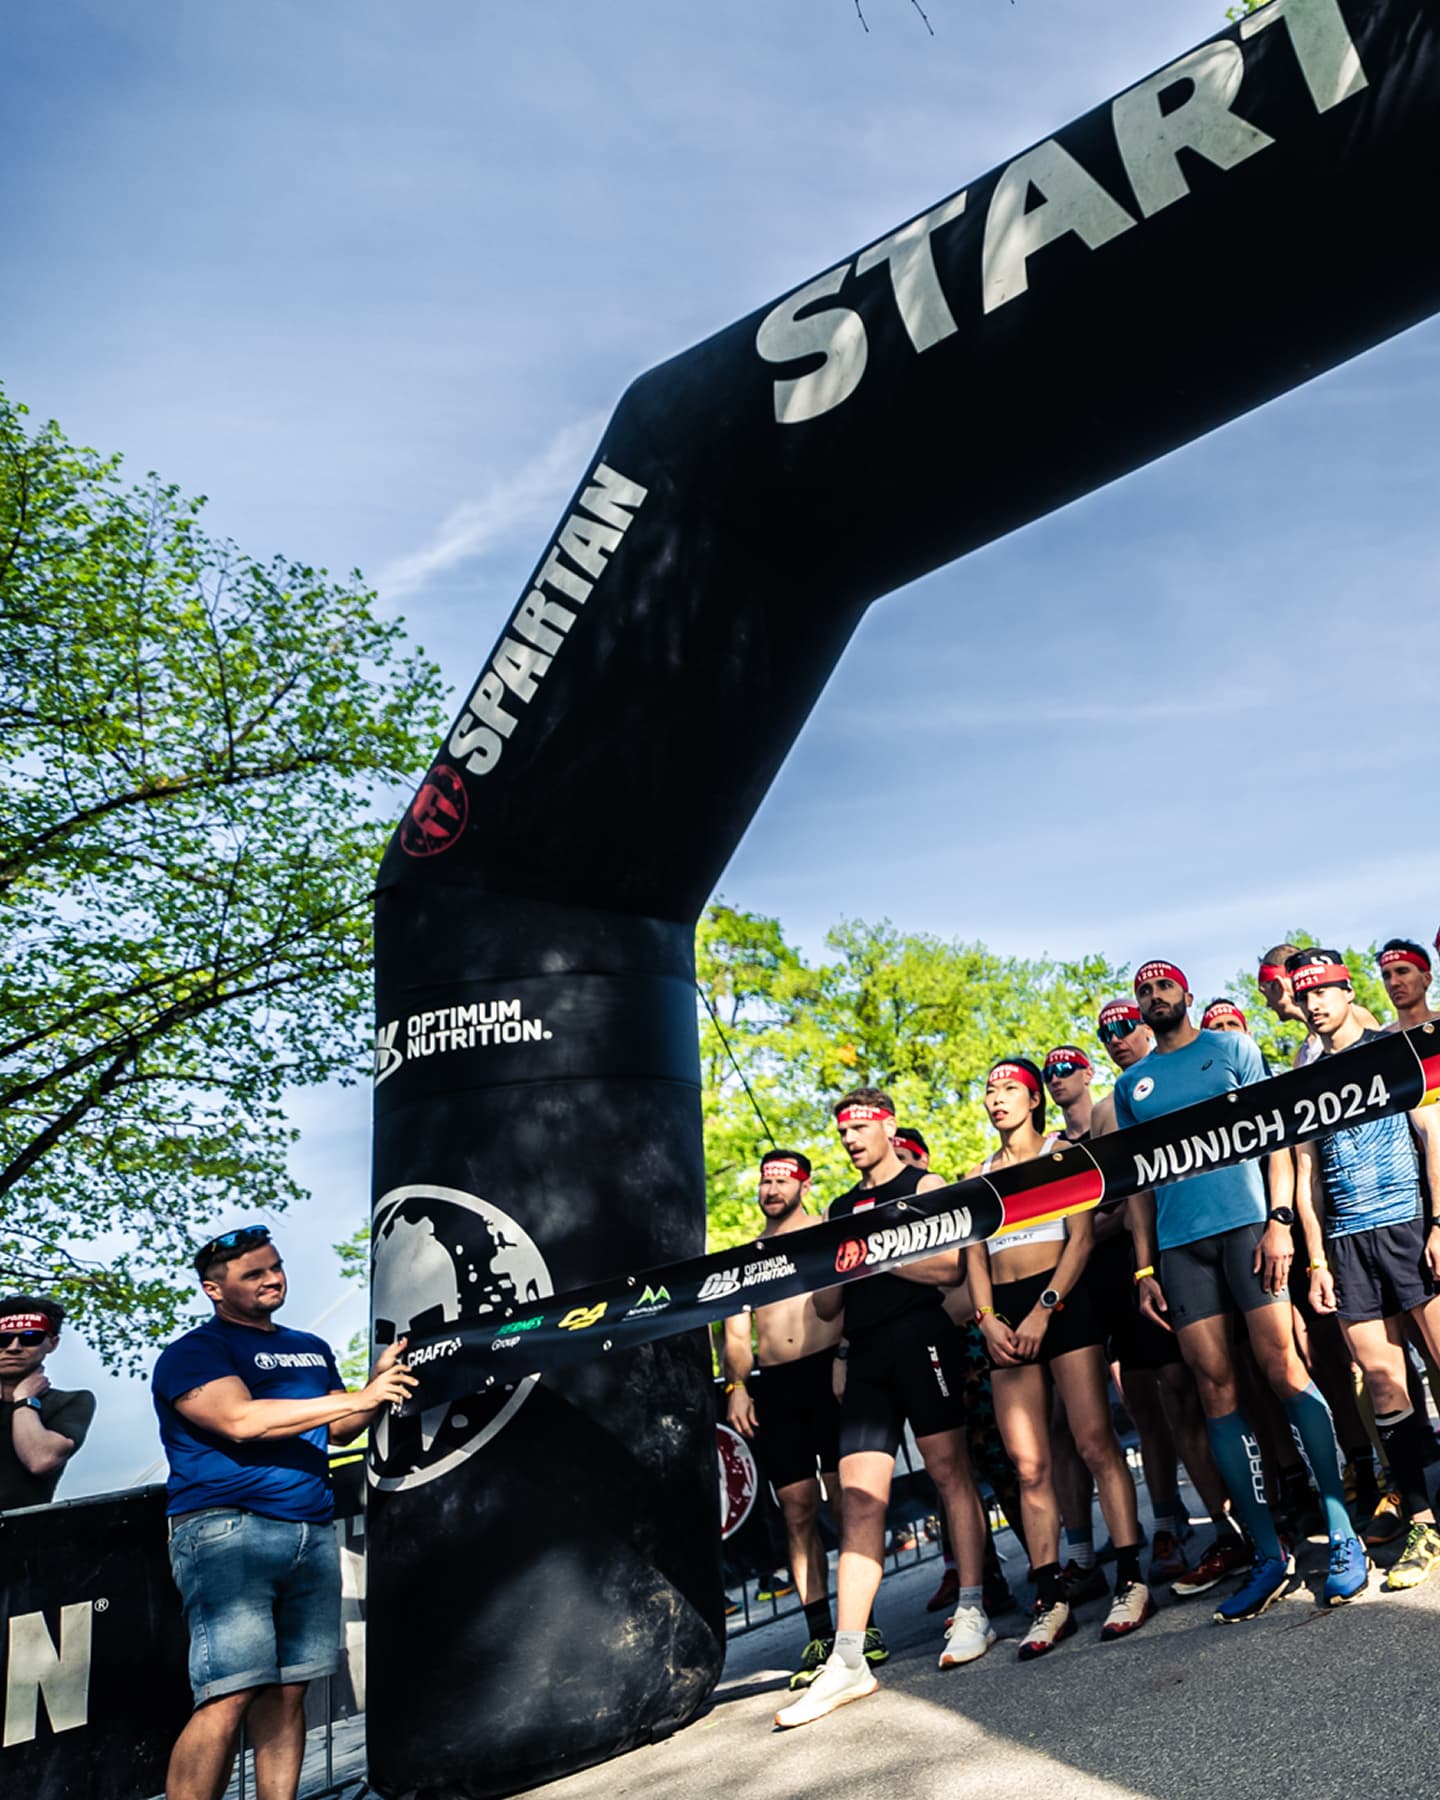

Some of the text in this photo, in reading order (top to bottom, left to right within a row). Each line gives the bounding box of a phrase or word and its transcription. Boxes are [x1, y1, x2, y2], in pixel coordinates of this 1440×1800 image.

[755, 0, 1369, 424] START
[448, 462, 648, 775] SPARTAN
[407, 999, 521, 1037] OPTIMUM
[407, 1019, 553, 1060] NUTRITION.
[1133, 1074, 1390, 1186] MUNICH 2024
[865, 1206, 973, 1265] SPARTAN
